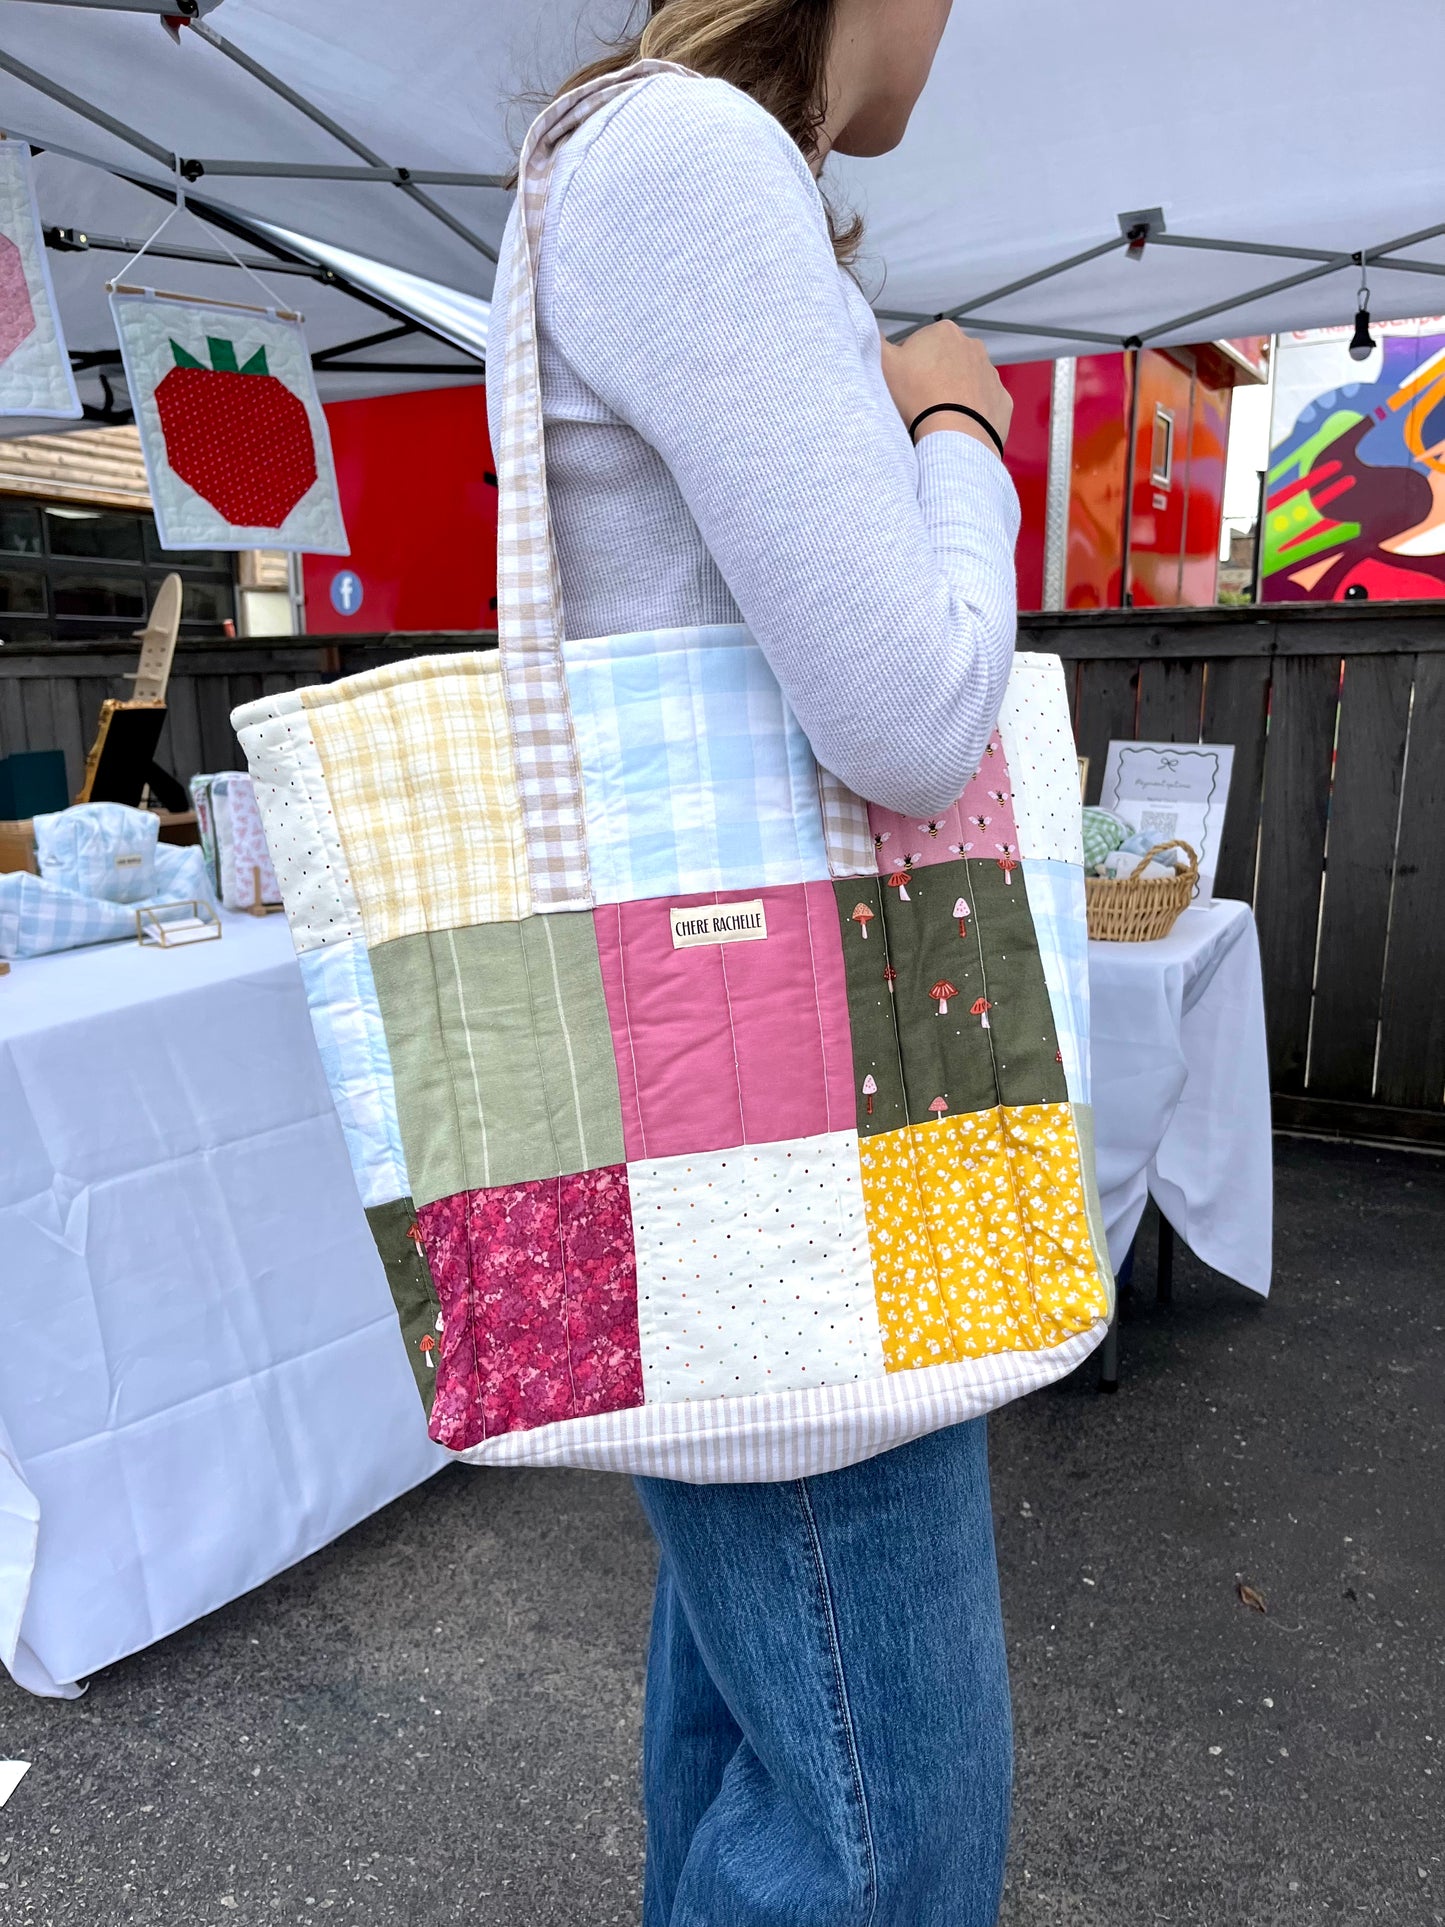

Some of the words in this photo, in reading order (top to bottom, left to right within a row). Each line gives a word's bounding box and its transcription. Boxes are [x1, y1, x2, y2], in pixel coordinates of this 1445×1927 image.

[340, 576, 353, 610] f
[675, 918, 709, 937] CHERE
[713, 913, 762, 932] RACHELLE
